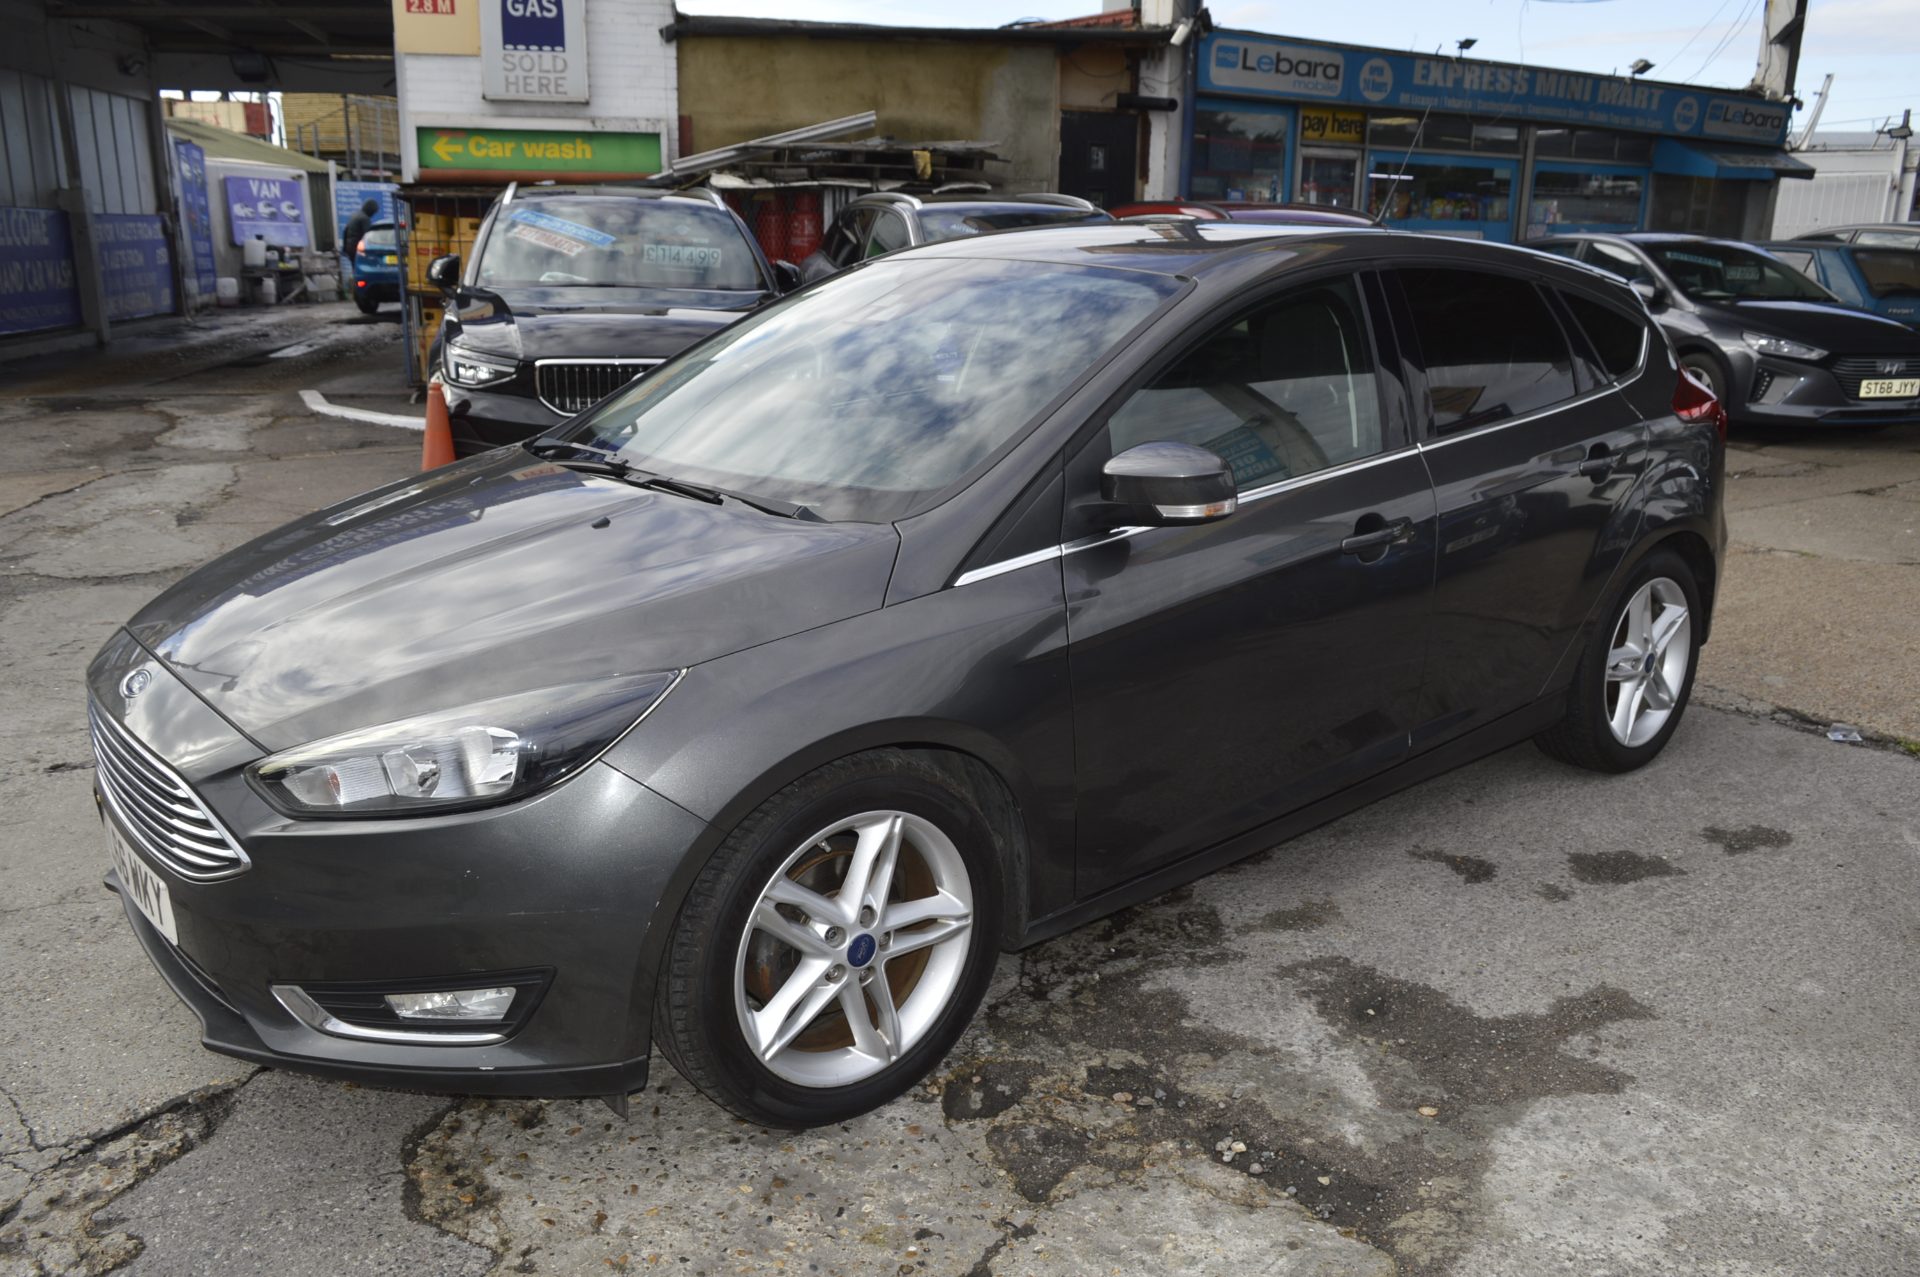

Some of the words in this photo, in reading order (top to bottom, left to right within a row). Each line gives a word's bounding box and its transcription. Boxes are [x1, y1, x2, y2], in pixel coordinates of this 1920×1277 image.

[409, 0, 432, 13] 2.8
[438, 0, 451, 14] M
[507, 0, 558, 18] GAS
[502, 54, 568, 74] SOLD
[1241, 48, 1340, 81] Lebara
[505, 76, 568, 95] HERE
[1292, 80, 1338, 94] mobile
[1413, 59, 1530, 95] EXPRESS
[1535, 71, 1592, 102] MINI
[1597, 80, 1665, 111] MART
[1302, 113, 1330, 138] pay
[1331, 112, 1363, 135] here
[1723, 105, 1783, 130] Lebara
[468, 136, 515, 158] Car
[523, 138, 592, 159] wash
[249, 179, 281, 198] VAN
